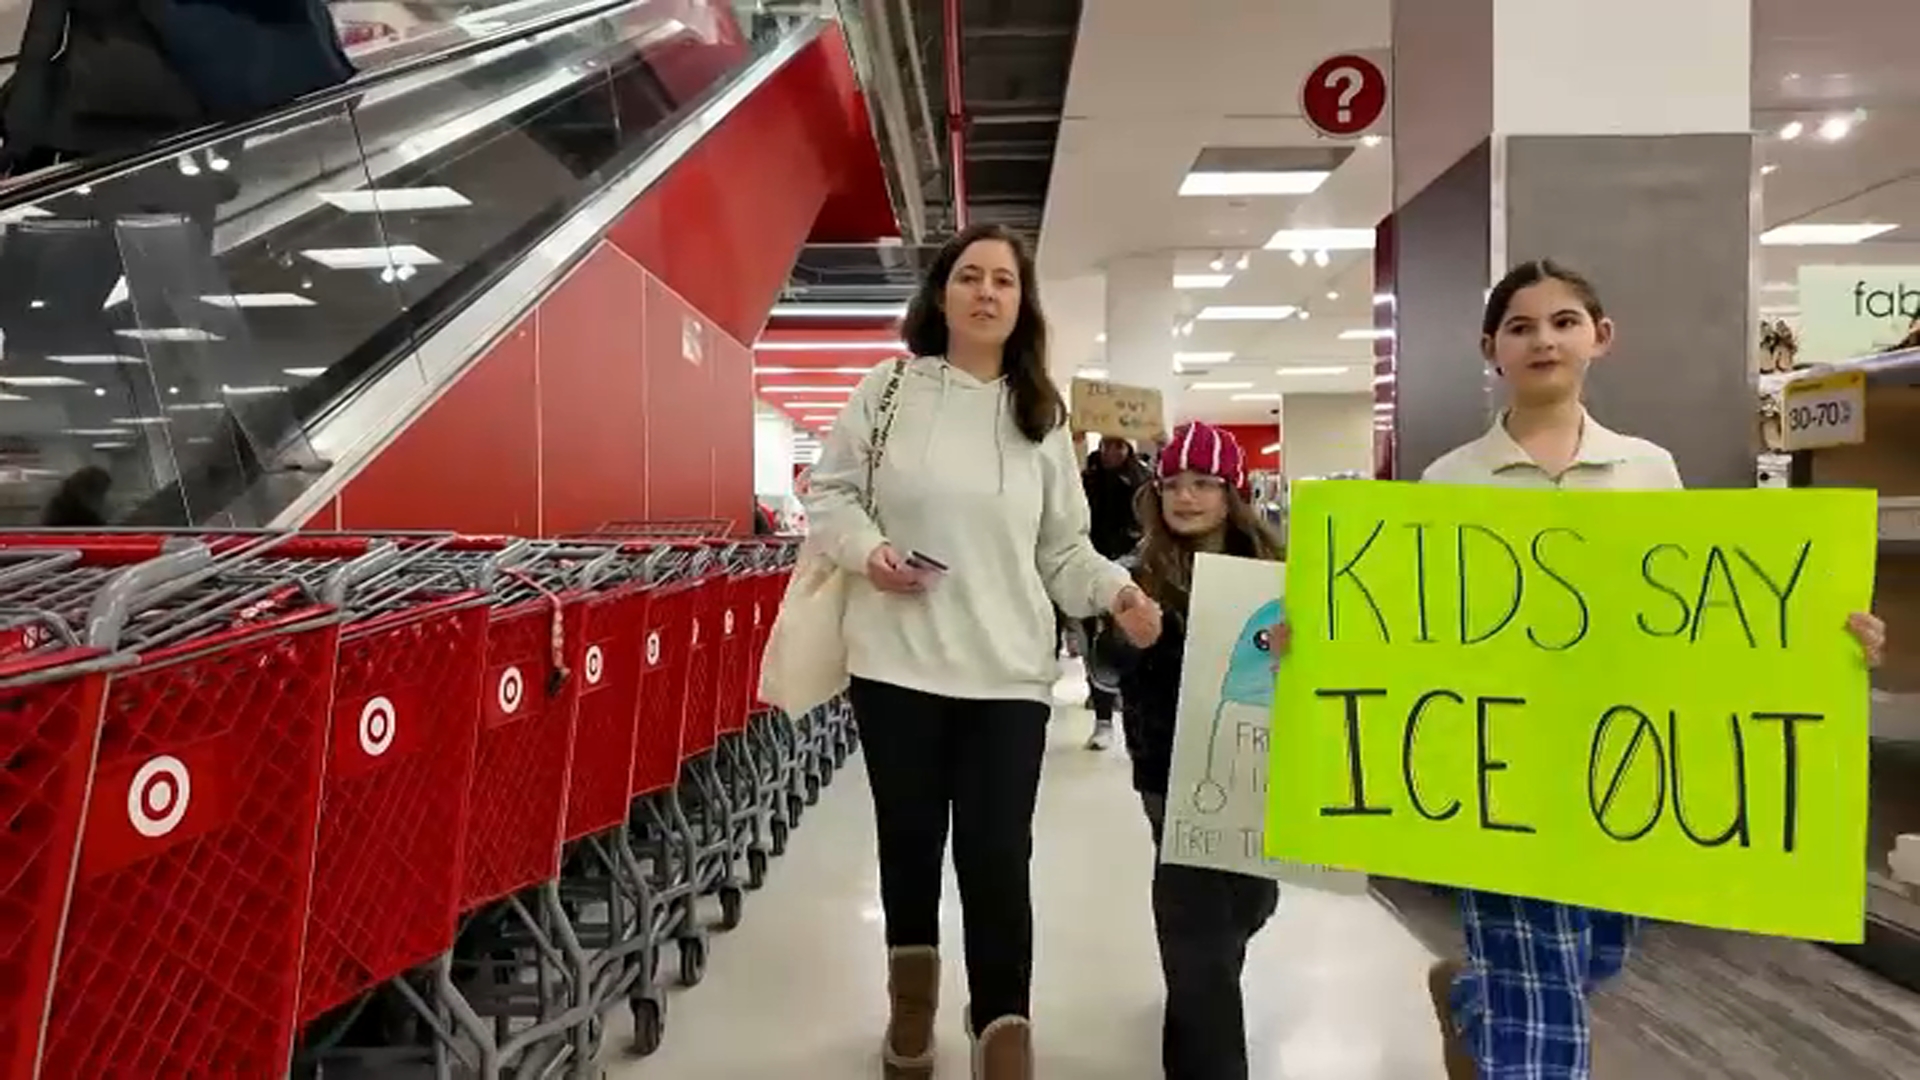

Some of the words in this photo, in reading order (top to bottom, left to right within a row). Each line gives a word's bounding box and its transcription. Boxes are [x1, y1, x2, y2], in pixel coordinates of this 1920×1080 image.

[1324, 66, 1364, 123] ?
[1326, 515, 1589, 651] KIDS
[1637, 540, 1811, 649] SAY
[1315, 689, 1537, 834] ICE
